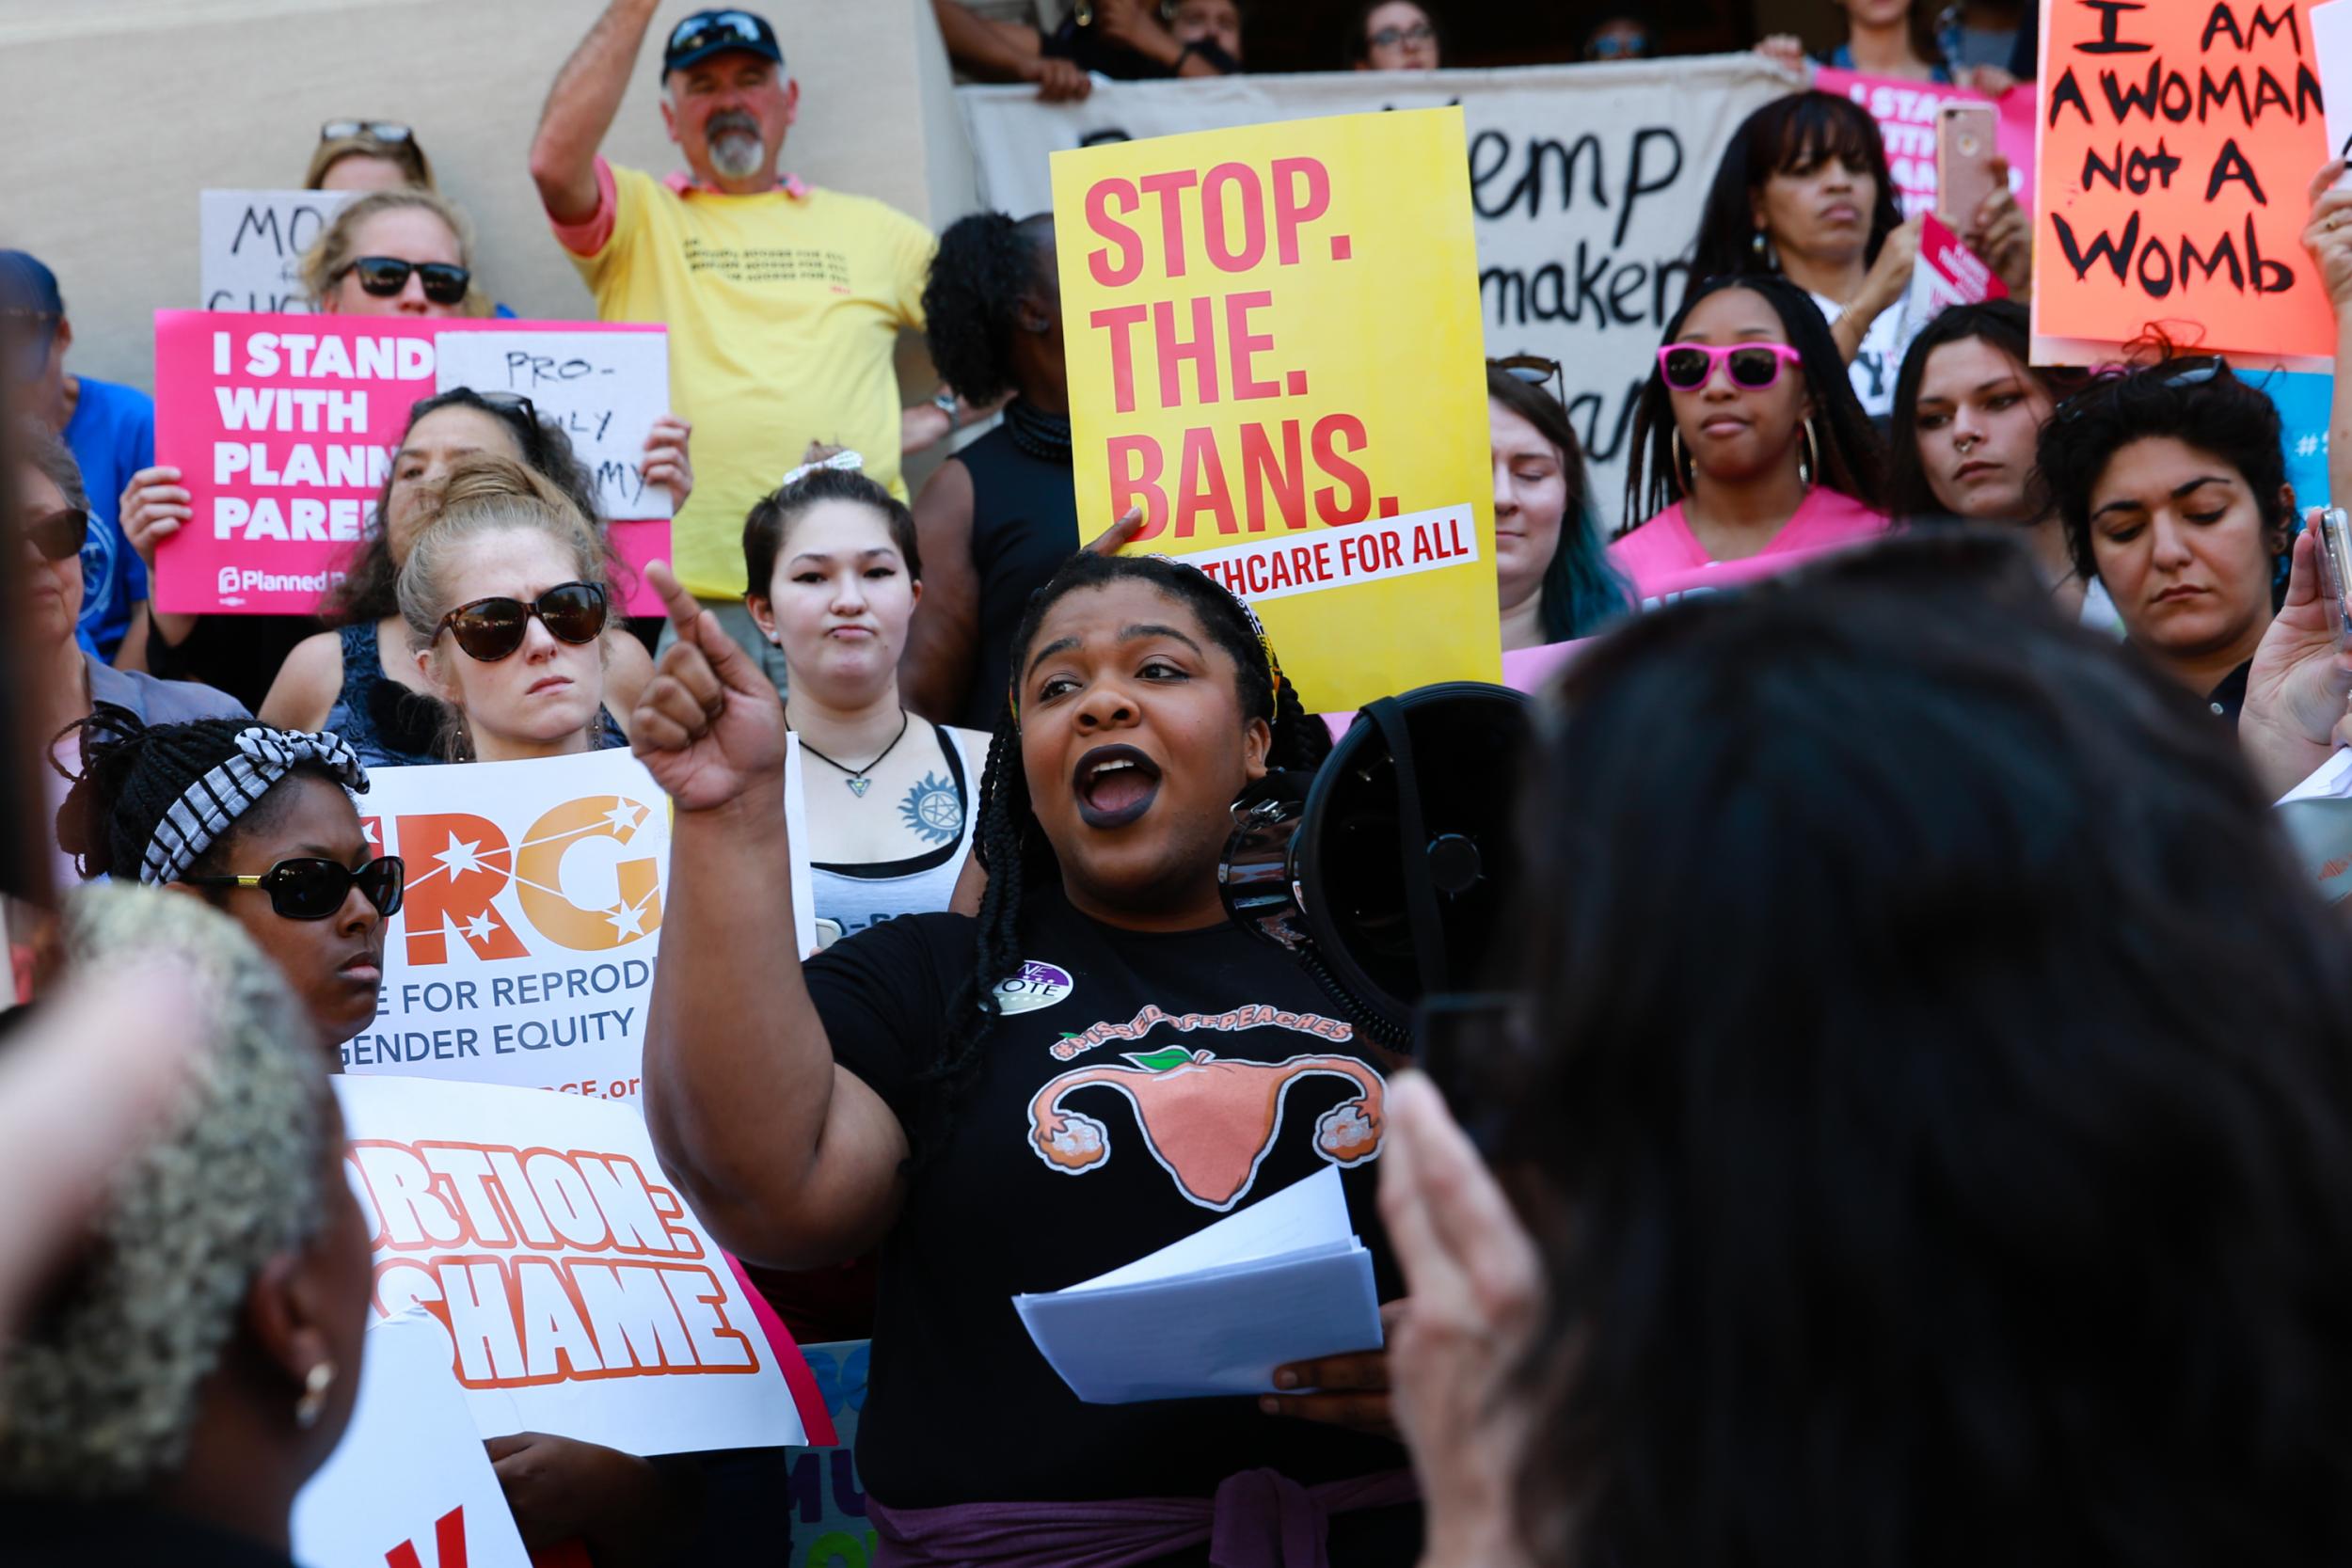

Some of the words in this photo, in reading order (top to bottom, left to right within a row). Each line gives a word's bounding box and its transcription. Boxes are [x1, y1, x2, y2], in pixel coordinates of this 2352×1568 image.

[2071, 0, 2154, 54] I
[2201, 2, 2301, 56] AM
[2049, 64, 2093, 129] A
[2099, 55, 2325, 128] WOMAN
[1469, 129, 1683, 248] emp
[2204, 138, 2267, 207] A
[1085, 156, 1352, 287] STOP.
[214, 331, 231, 375] I
[245, 331, 436, 380] STAND
[506, 351, 615, 388] PRO-
[1089, 290, 1309, 414] THE.
[214, 387, 368, 433] WITH
[1106, 413, 1399, 543] BANS.
[1340, 531, 1403, 578] FOR
[1412, 518, 1470, 563] ALL
[242, 570, 327, 593] Planned
[360, 795, 663, 967] RG
[403, 981, 479, 1014] FOR
[492, 957, 660, 1007] REPROD
[1002, 979, 1061, 997] OTE
[493, 1006, 636, 1054] EQUITY
[343, 1139, 706, 1260] RTION:
